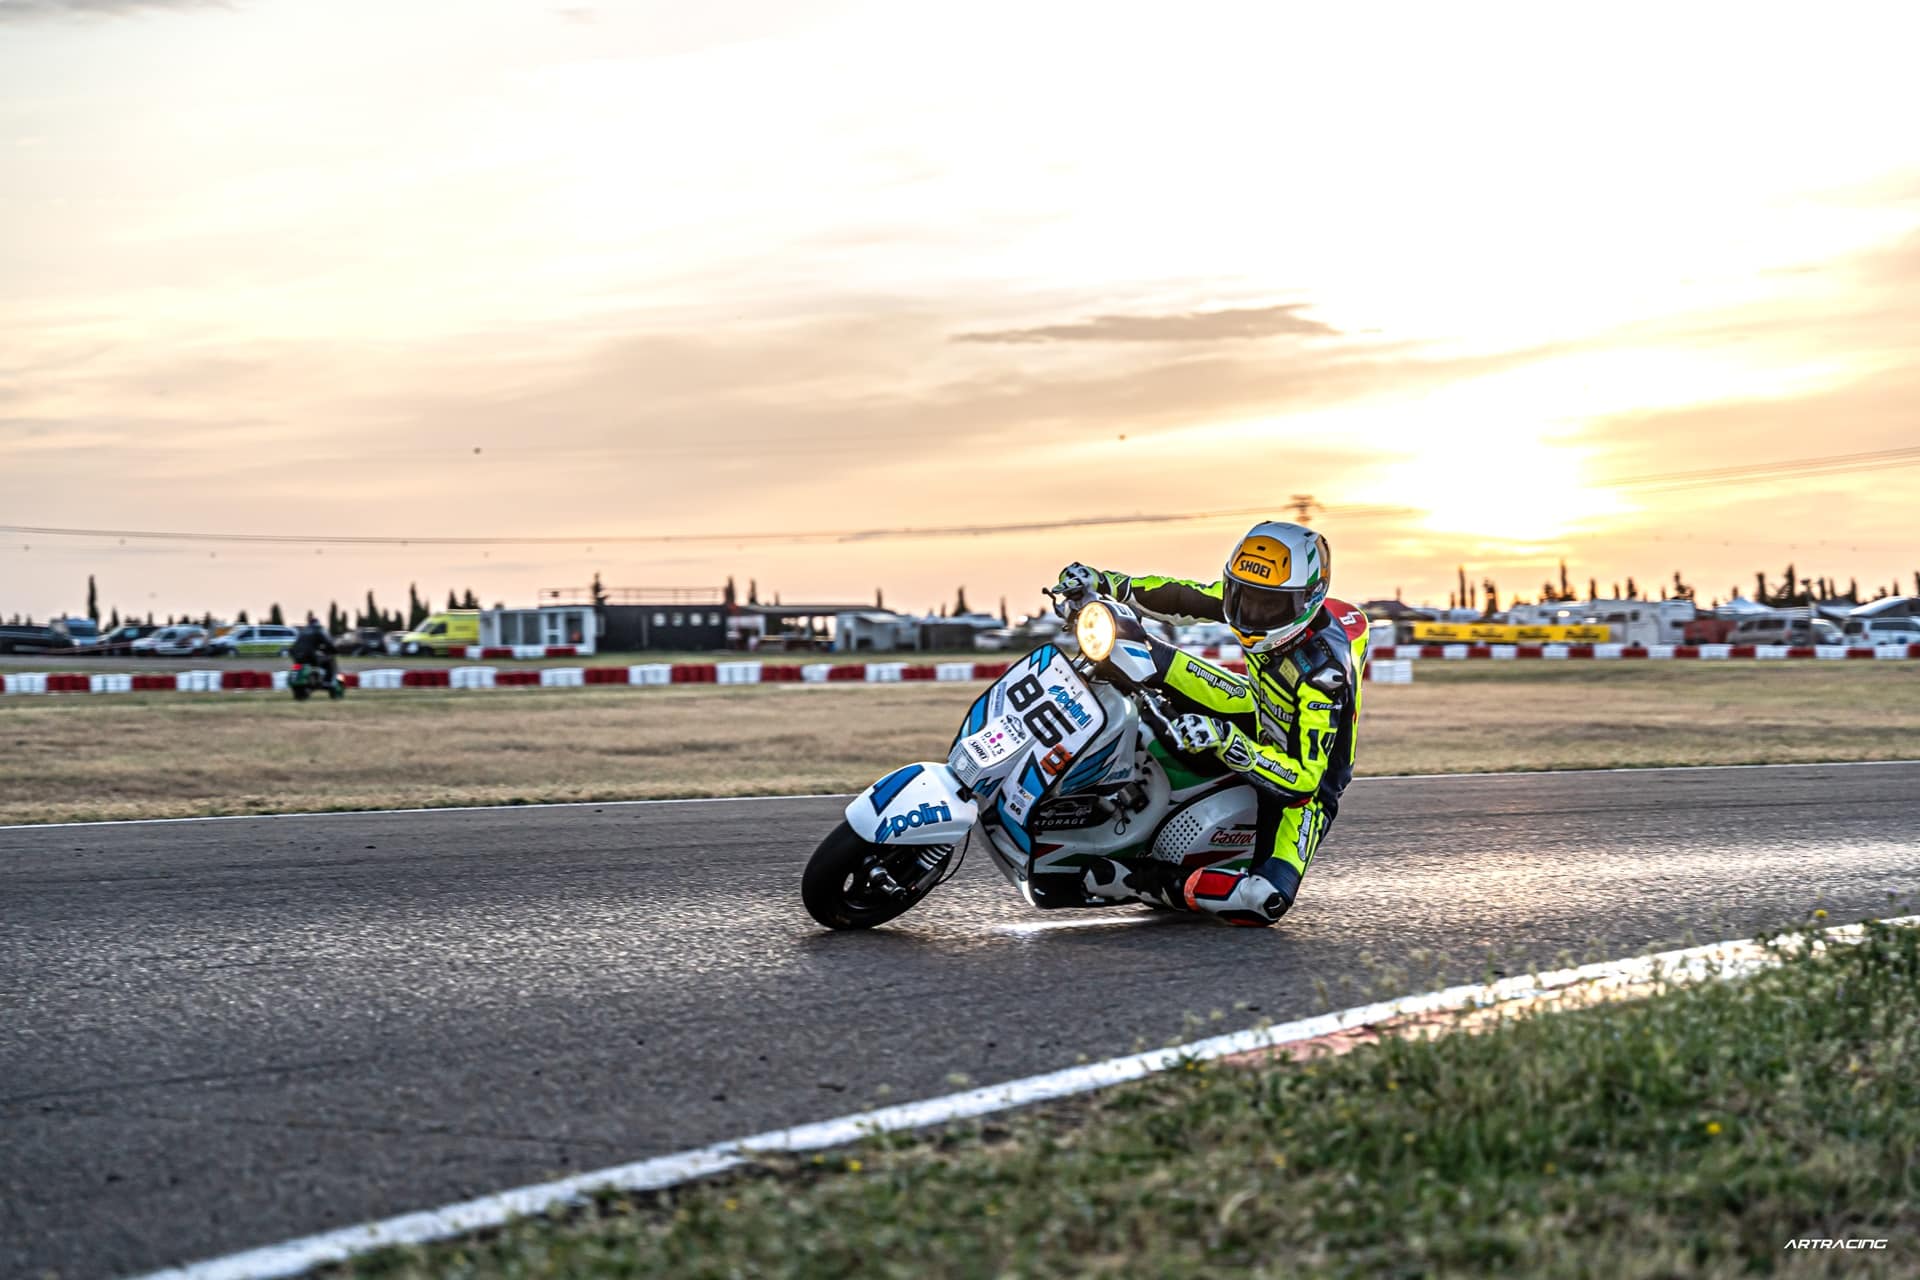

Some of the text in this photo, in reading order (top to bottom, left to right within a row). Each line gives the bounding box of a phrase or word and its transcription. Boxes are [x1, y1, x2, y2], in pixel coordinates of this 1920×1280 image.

[1238, 559, 1272, 580] SHOEI
[1006, 673, 1076, 748] 86
[890, 801, 953, 839] polini
[1210, 830, 1257, 844] Castrol
